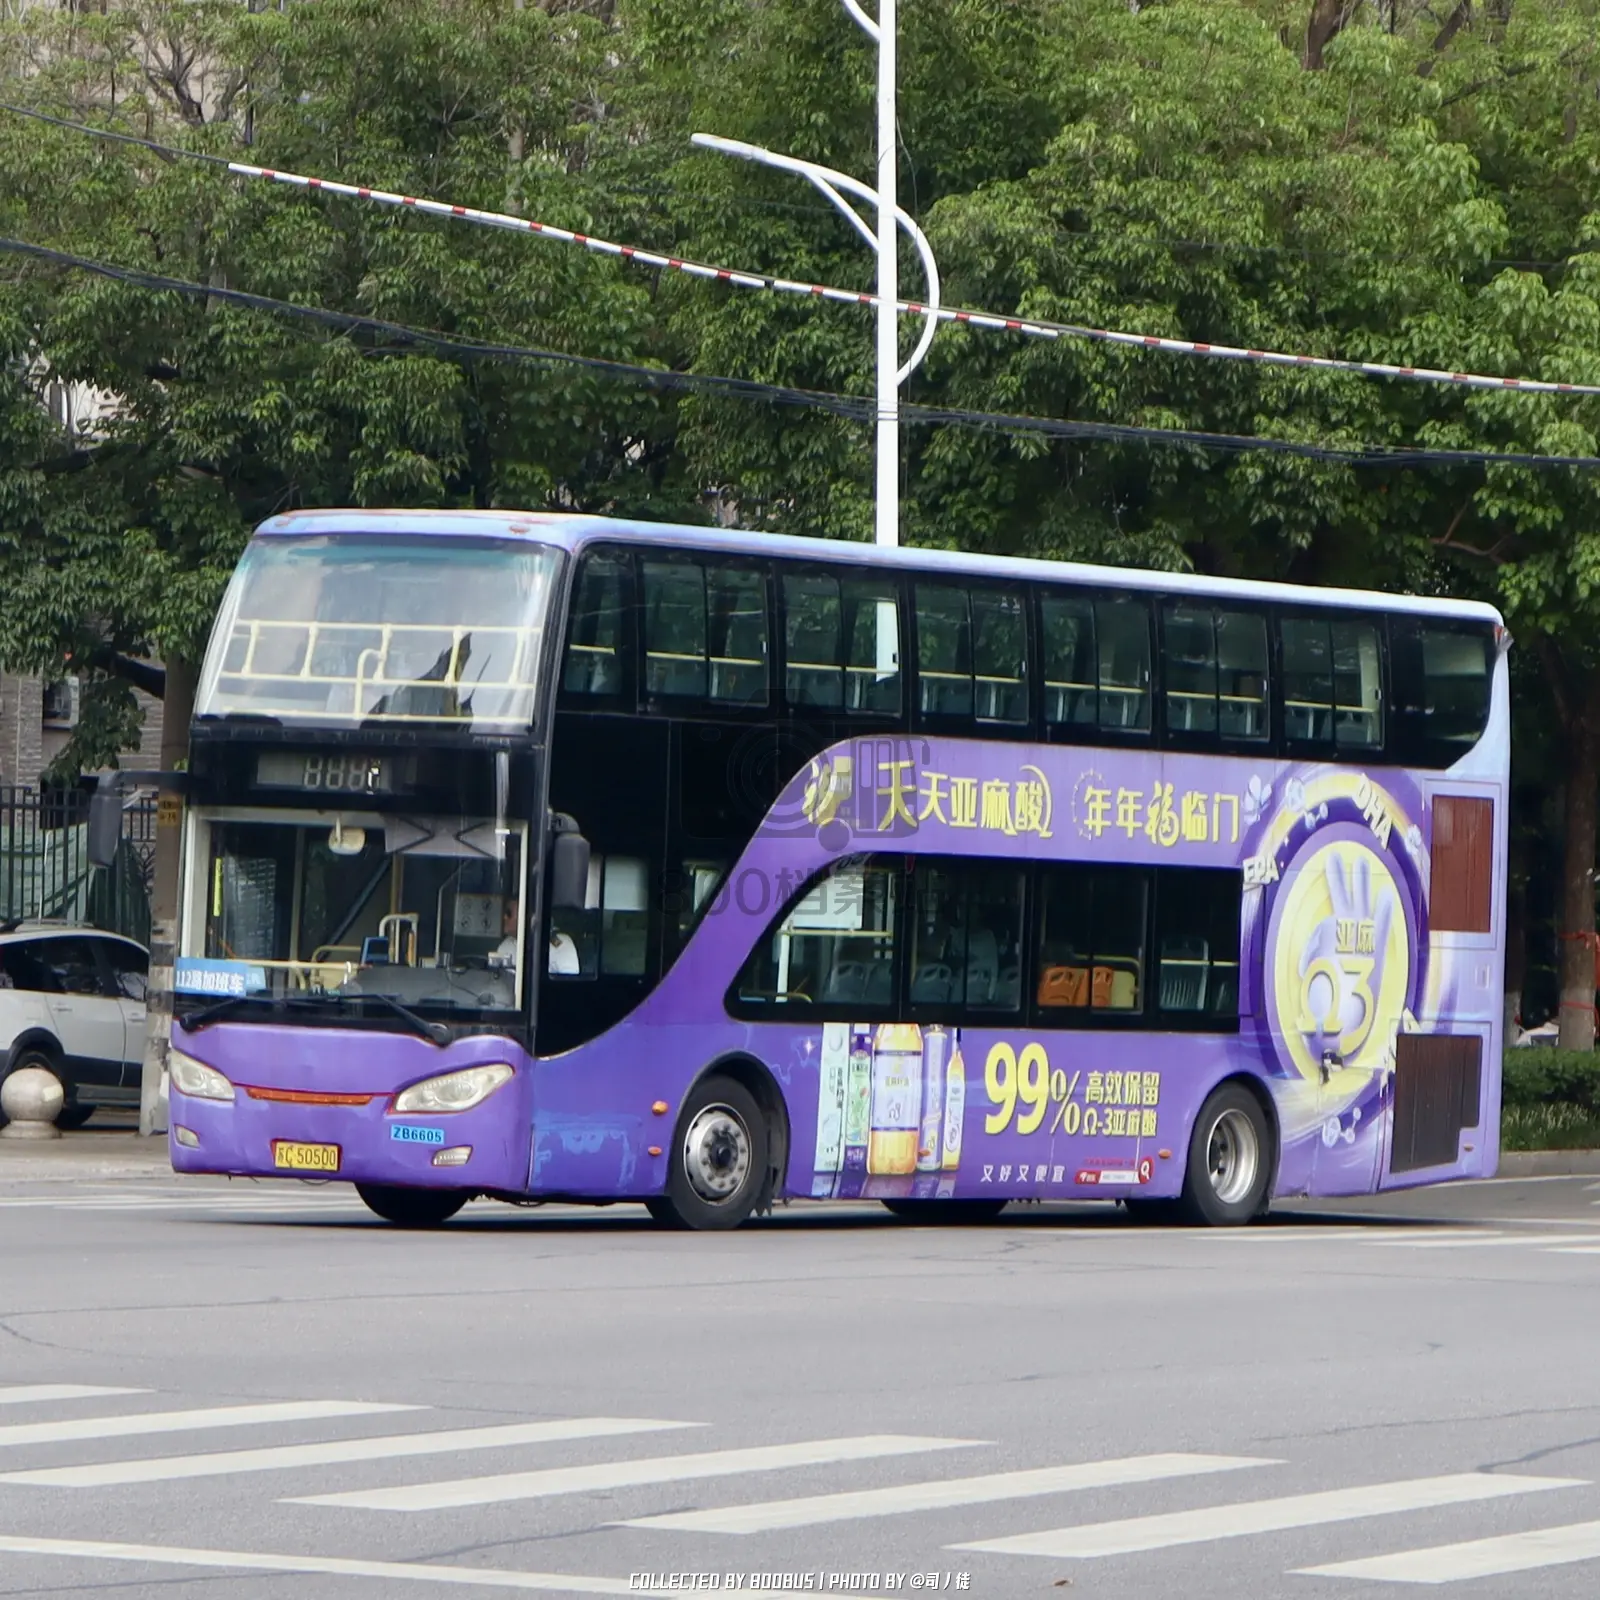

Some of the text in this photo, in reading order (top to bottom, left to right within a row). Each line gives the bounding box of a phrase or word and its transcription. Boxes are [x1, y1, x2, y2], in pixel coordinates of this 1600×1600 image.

[1083, 780, 1240, 847] 年年福临门
[1350, 772, 1394, 850] DHA
[1242, 852, 1280, 885] EPA
[1337, 918, 1376, 956] 亚麻
[983, 1041, 1081, 1136] 99%
[1085, 1070, 1160, 1105] 高效保留
[394, 1126, 443, 1143] ZB6605
[980, 1163, 1066, 1183] 又好又便宜
